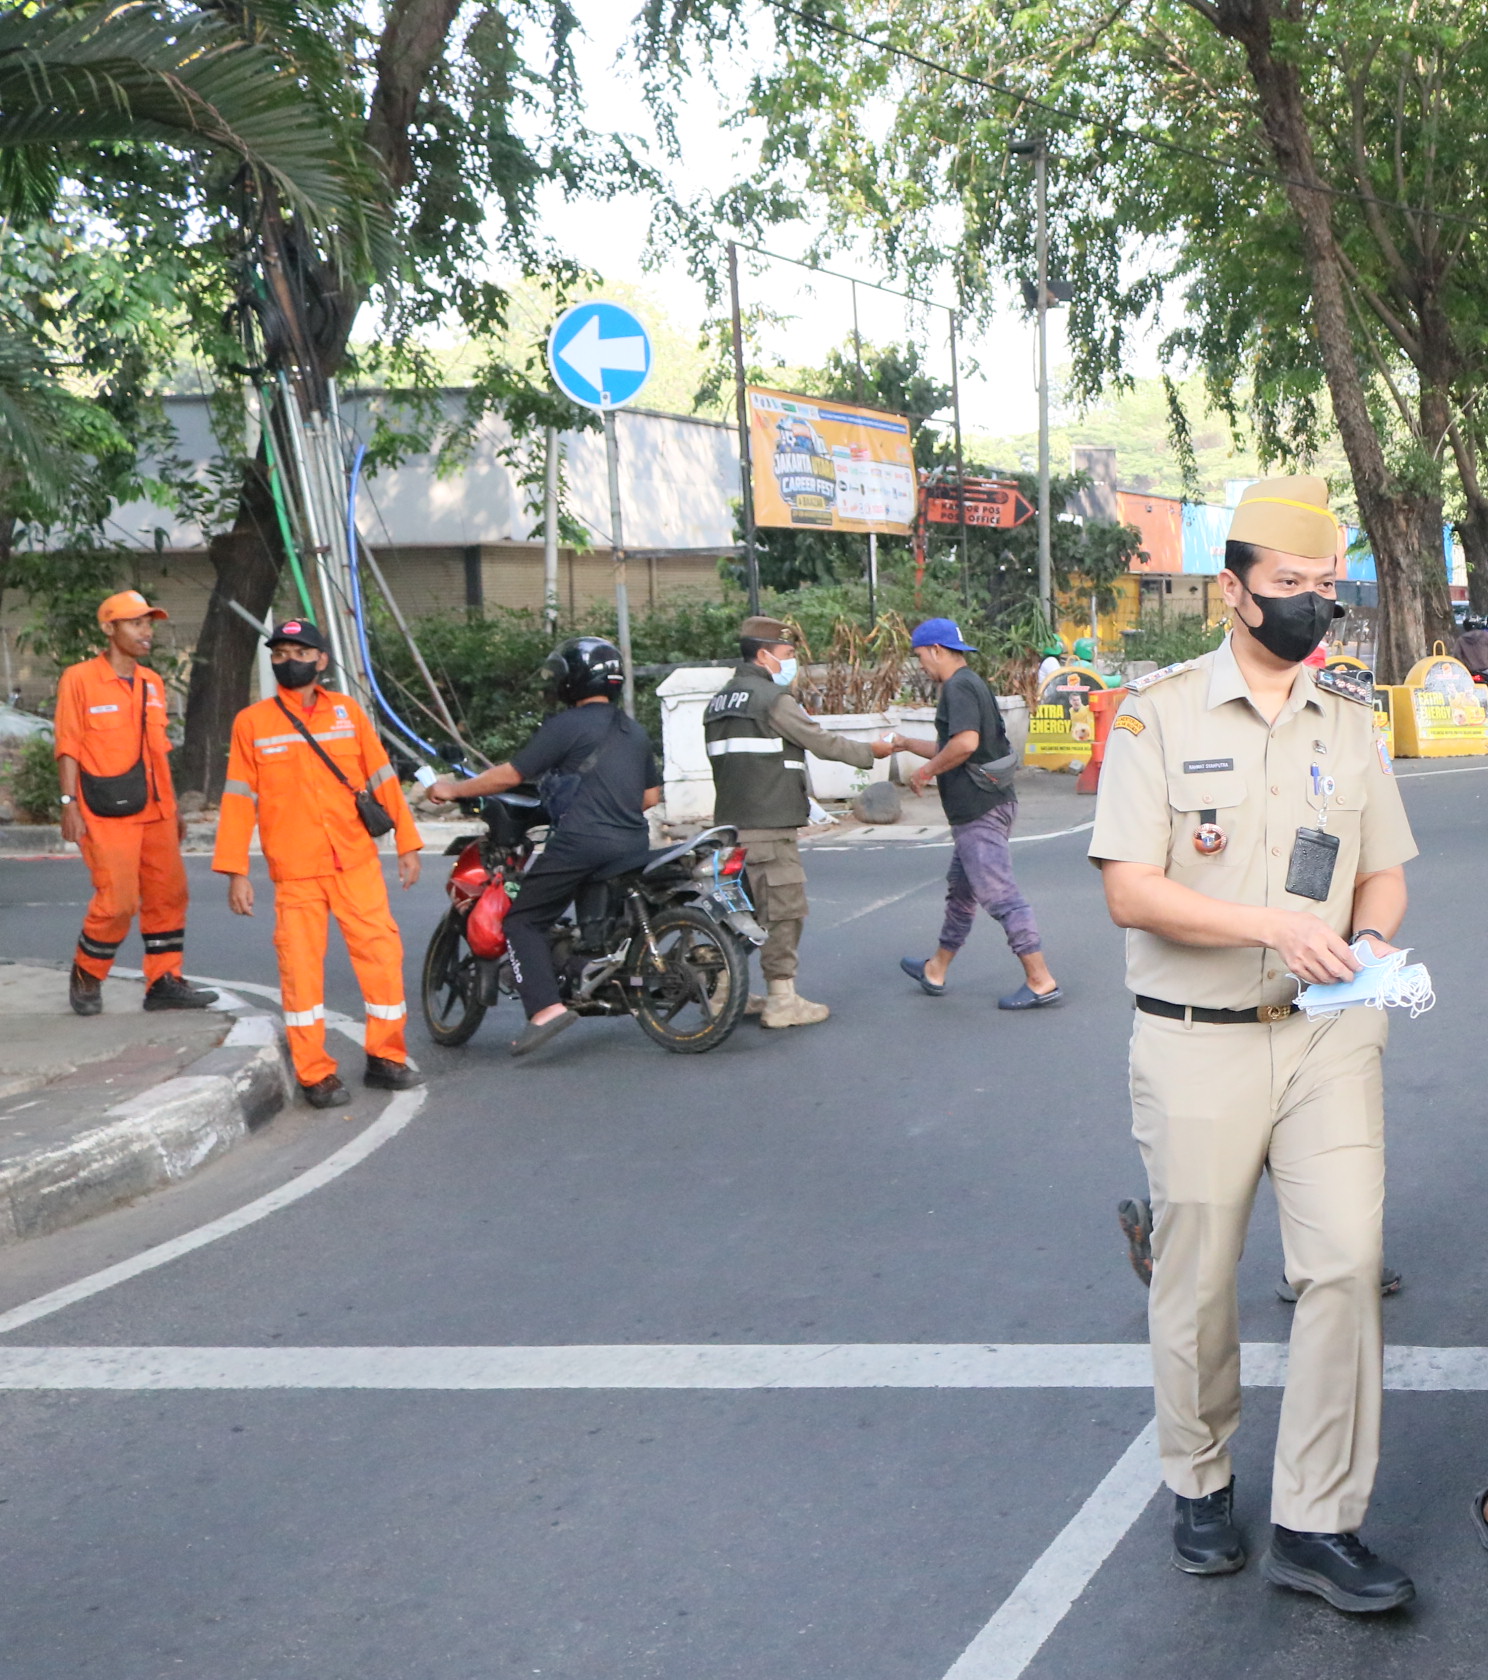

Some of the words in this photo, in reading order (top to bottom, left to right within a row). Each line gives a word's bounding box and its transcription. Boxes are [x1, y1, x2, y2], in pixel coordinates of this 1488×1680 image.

[941, 502, 980, 513] KAOR
[982, 505, 1001, 514] POS
[941, 512, 963, 521] POS
[968, 514, 1001, 524] OFFICE
[727, 691, 749, 709] PP
[1029, 719, 1071, 734] ENERGY
